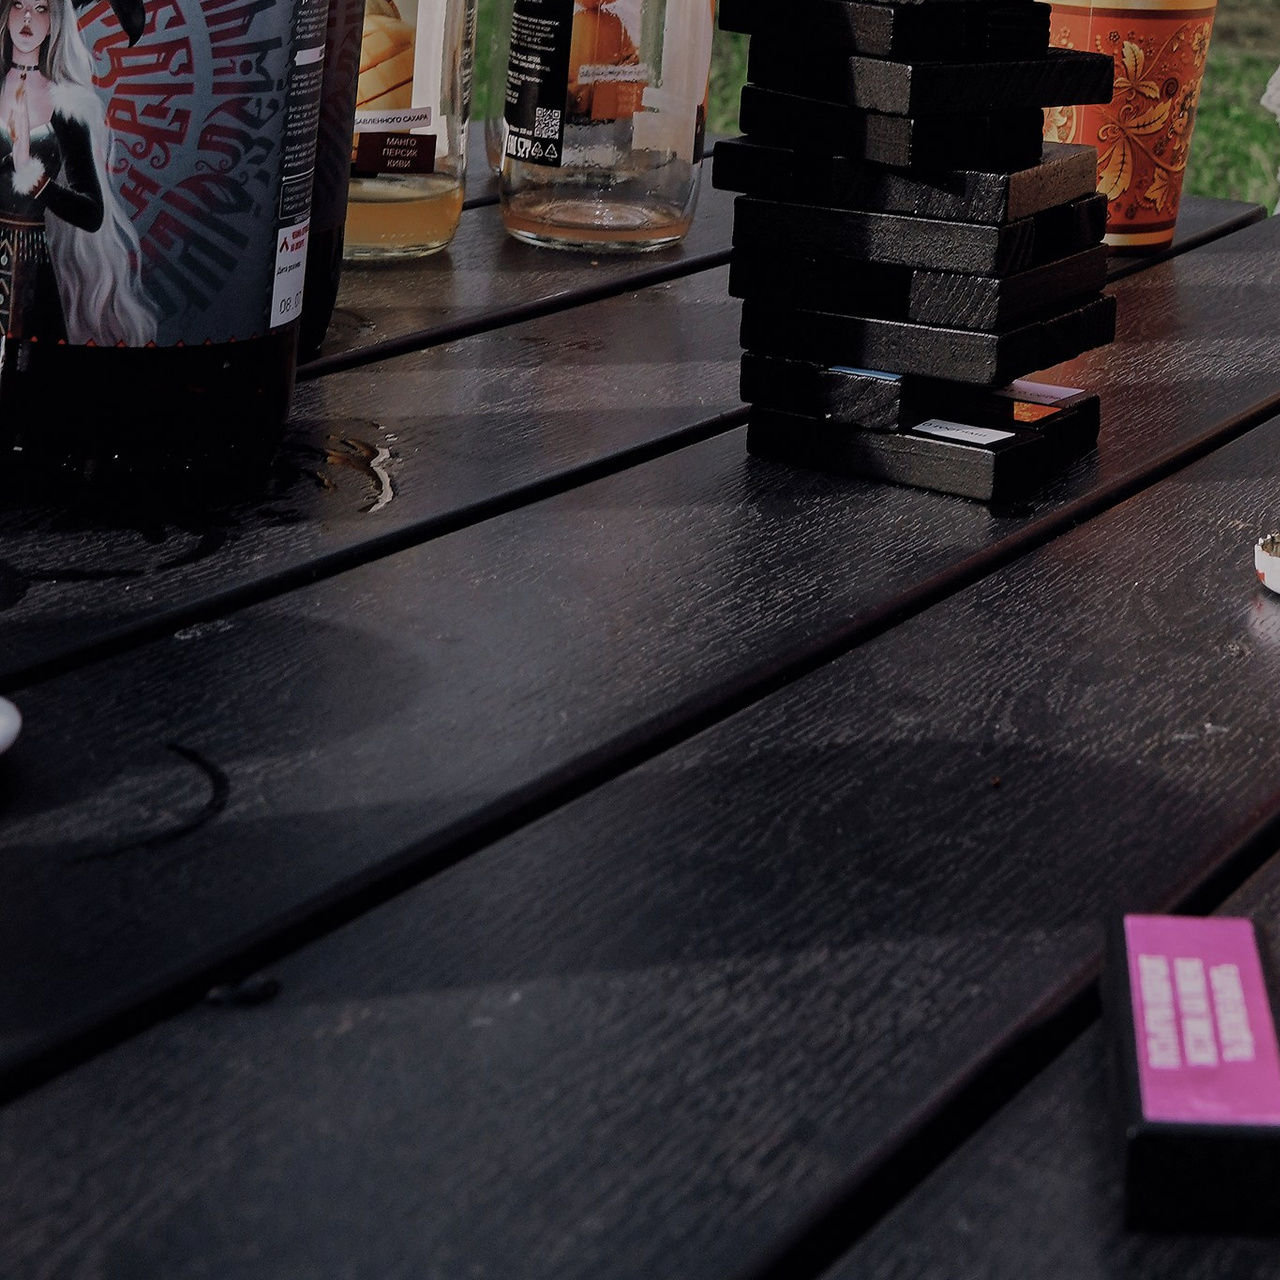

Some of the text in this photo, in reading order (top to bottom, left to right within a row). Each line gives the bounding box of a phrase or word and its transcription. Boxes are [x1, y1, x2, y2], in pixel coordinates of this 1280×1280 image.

[403, 113, 428, 123] САХАРА
[386, 137, 417, 146] МАНГО
[381, 148, 418, 157] ПЕРСИК
[386, 159, 412, 168] КИВИ
